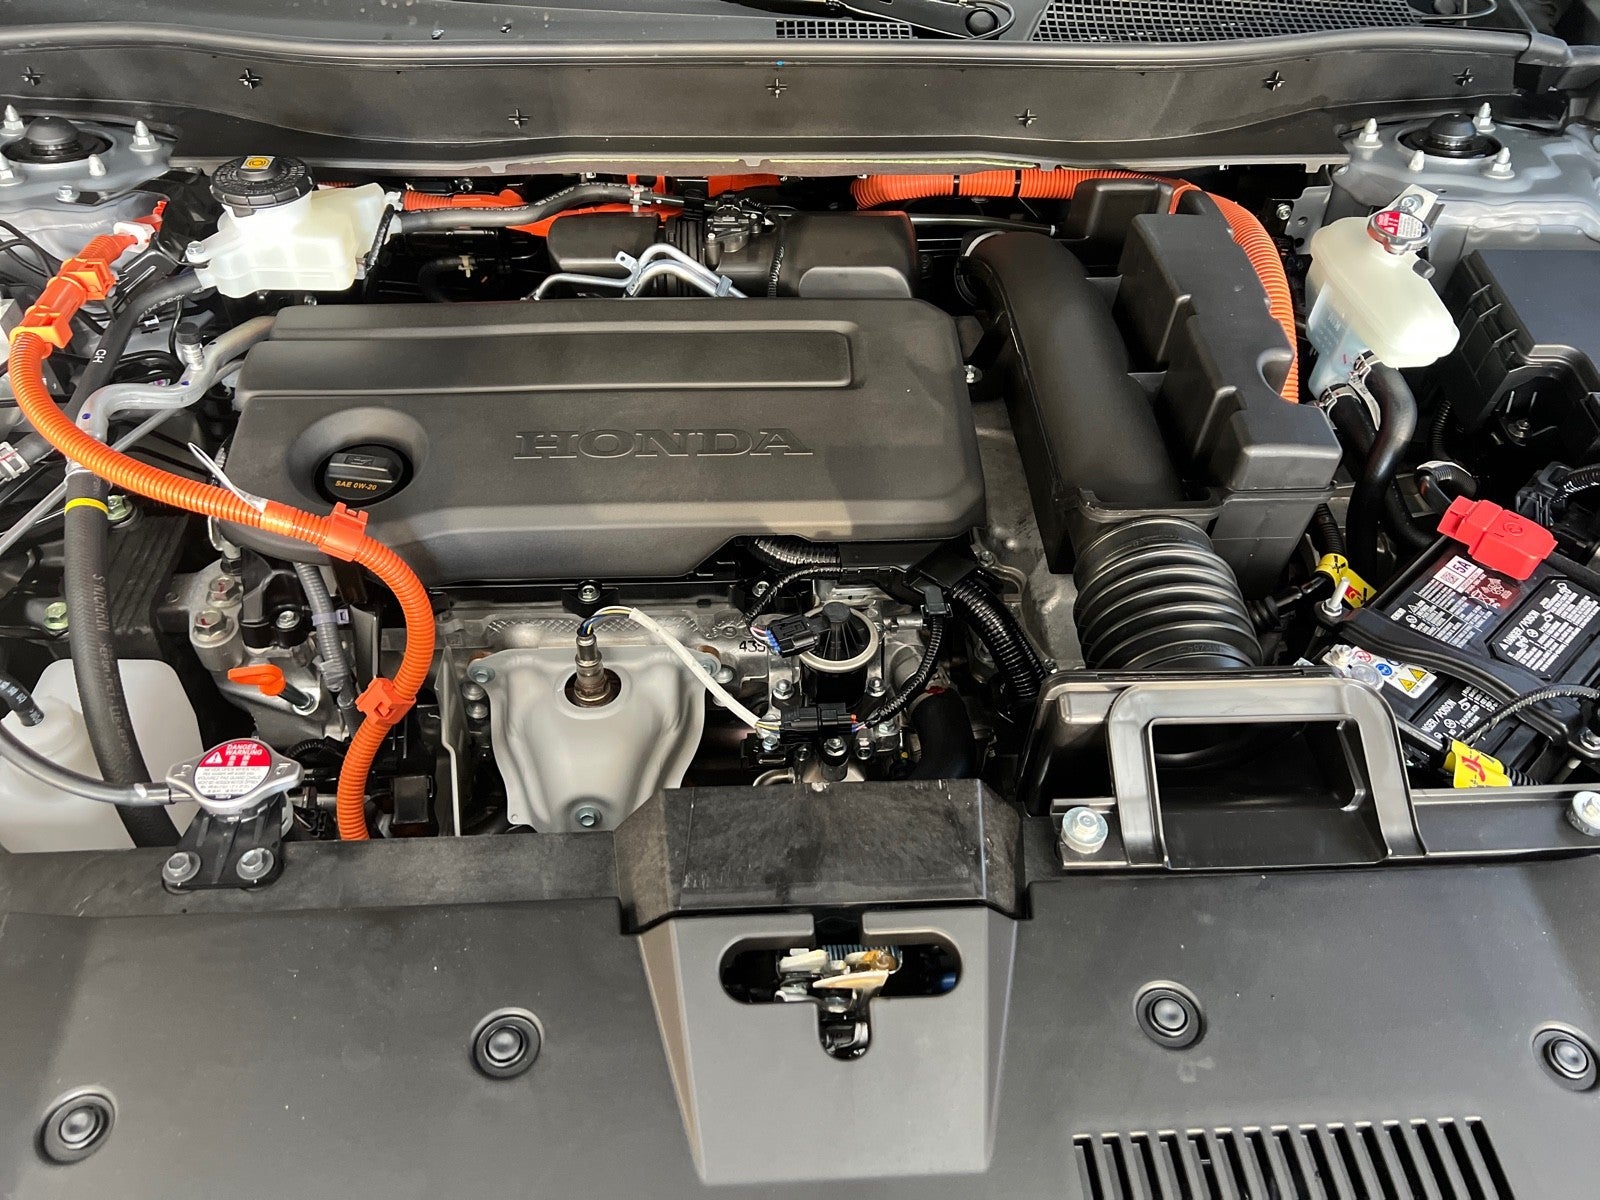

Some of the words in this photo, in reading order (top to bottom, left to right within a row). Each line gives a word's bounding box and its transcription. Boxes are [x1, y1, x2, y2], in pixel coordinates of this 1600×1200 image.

[92, 348, 107, 364] CH
[513, 427, 814, 459] HONDA
[334, 480, 352, 488] SAE
[353, 481, 378, 491] 0W-20
[1452, 560, 1471, 573] 5A
